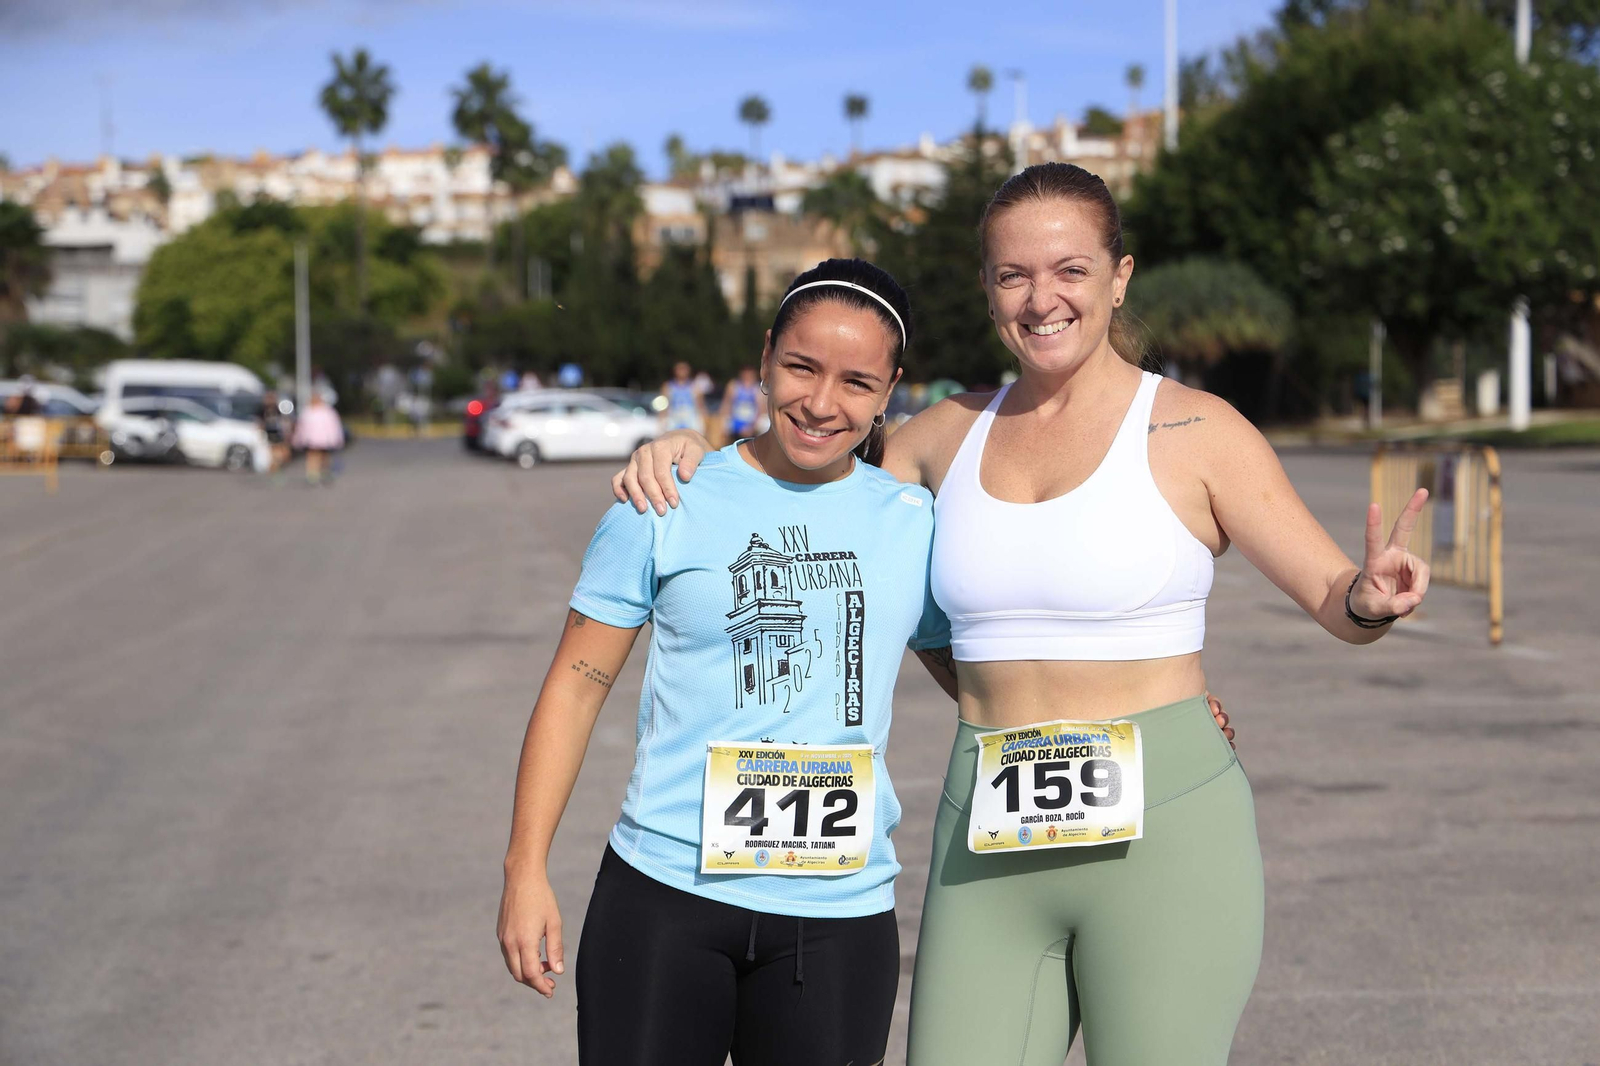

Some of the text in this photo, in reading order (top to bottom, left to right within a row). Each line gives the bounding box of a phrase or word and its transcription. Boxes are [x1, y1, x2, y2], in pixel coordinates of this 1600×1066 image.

[778, 524, 809, 553] XXV
[795, 551, 857, 562] CARRERA
[794, 561, 863, 591] URBANA
[846, 595, 863, 722] ALGECIRAS
[783, 629, 823, 714] 2025
[1001, 733, 1111, 753] CARRERA URBANA
[1004, 732, 1017, 742] XXV
[1018, 728, 1042, 740] EDICIÓN
[738, 750, 786, 760] XXV EDICIÓN
[1000, 745, 1112, 766] CIUDAD DE ALGECIRAS
[736, 759, 853, 775] CARRERA URBANA
[737, 773, 853, 788] CIUDAD DE ALGECIRAS
[991, 759, 1122, 813] 159
[724, 788, 859, 837] 412
[1020, 810, 1085, 825] GARCÍA BOZA, ROCÍO
[745, 840, 836, 850] RODRIGUEZ MACIAS, TATIANA
